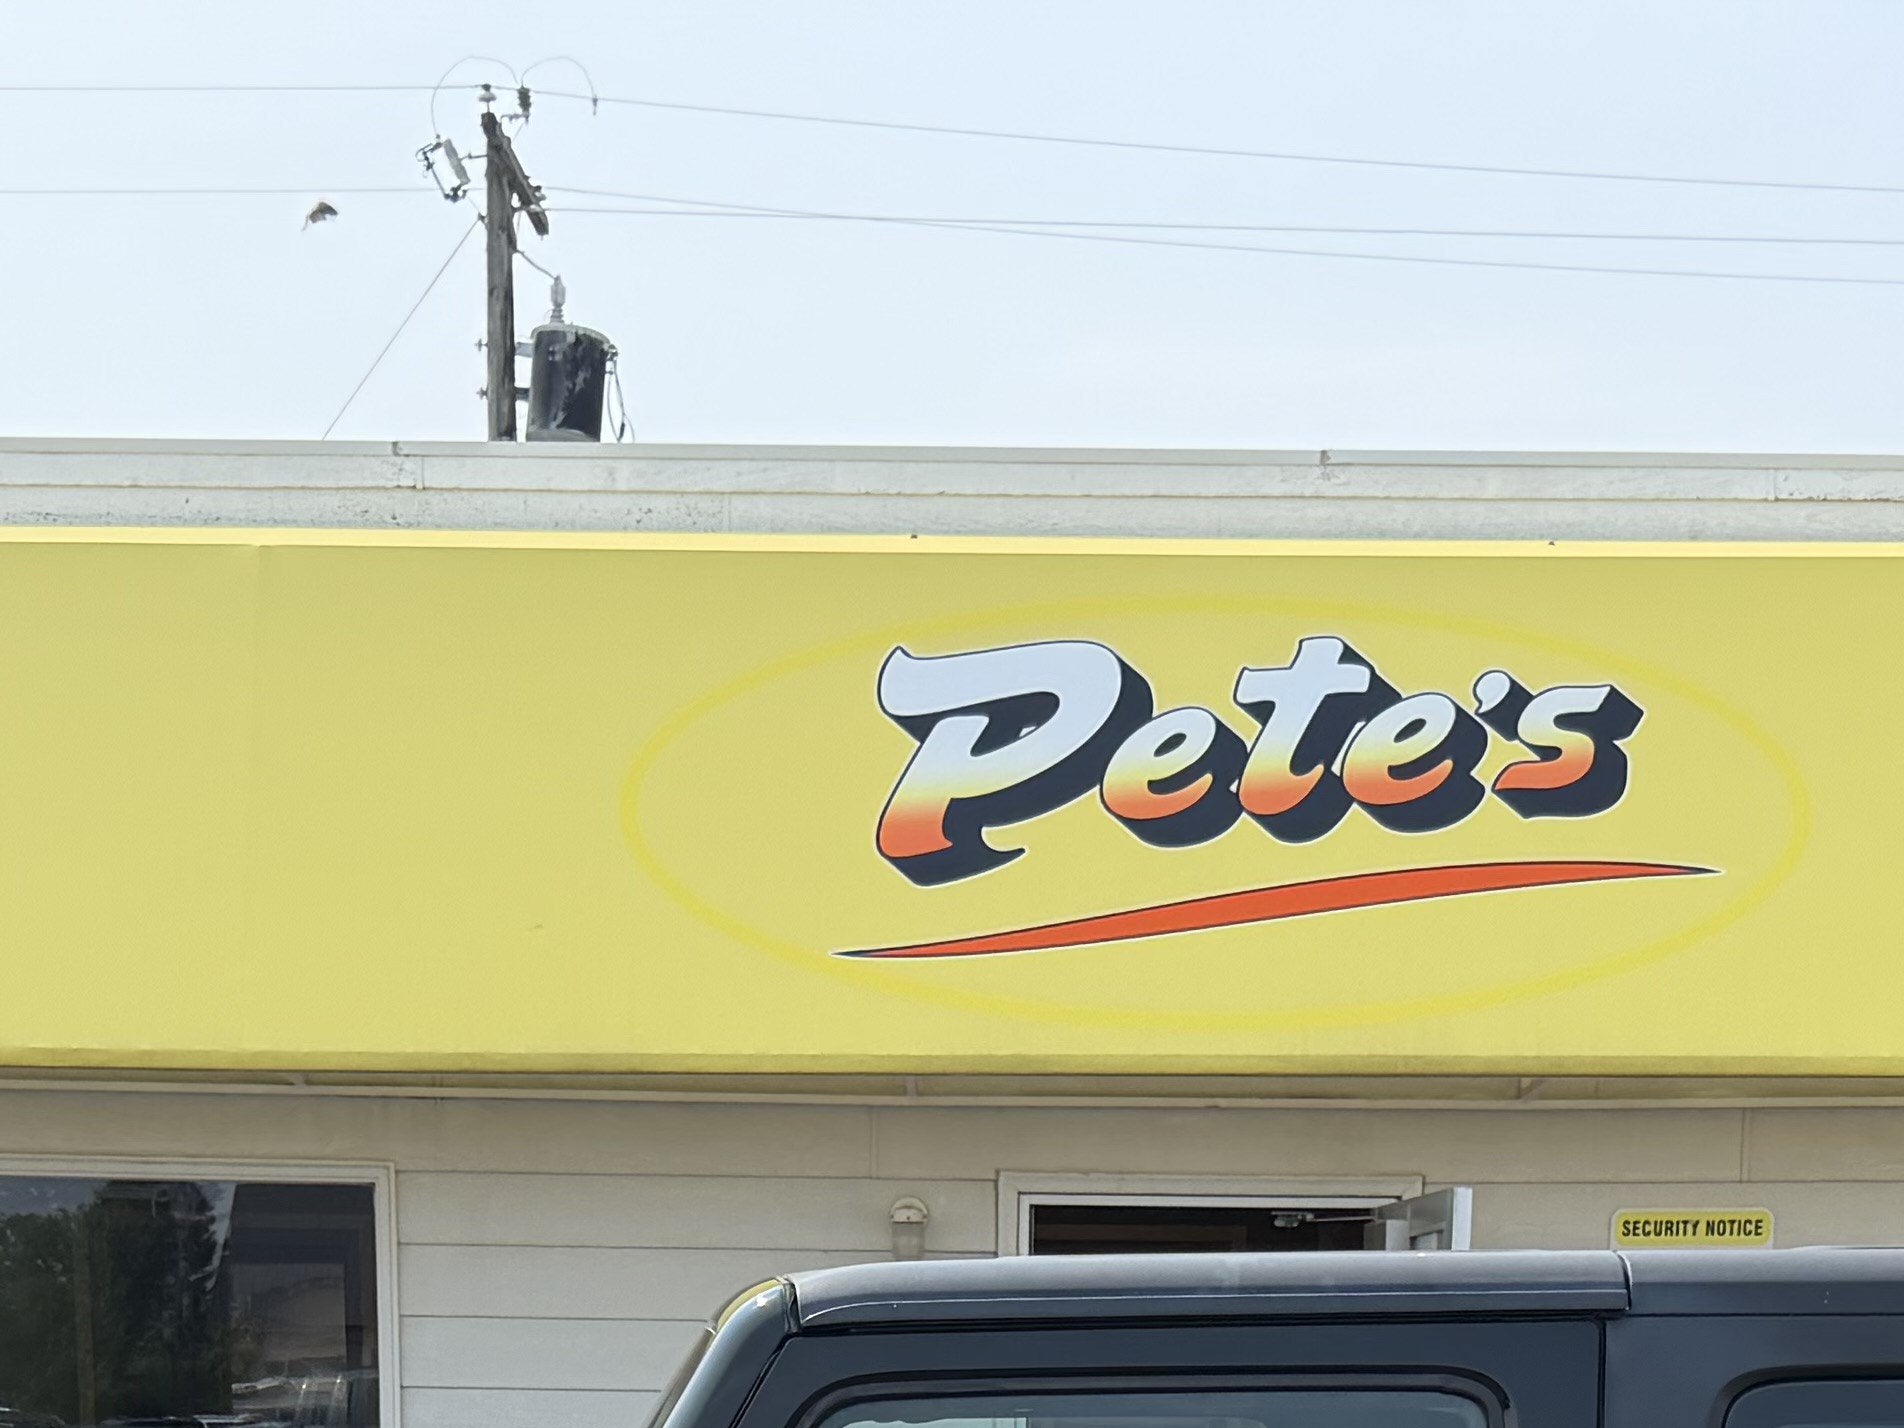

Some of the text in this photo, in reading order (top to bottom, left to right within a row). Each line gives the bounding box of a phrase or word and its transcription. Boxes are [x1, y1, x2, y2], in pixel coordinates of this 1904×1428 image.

[876, 635, 1646, 887] Pete's
[1621, 1218, 1764, 1238] SECURITY NOTICE
